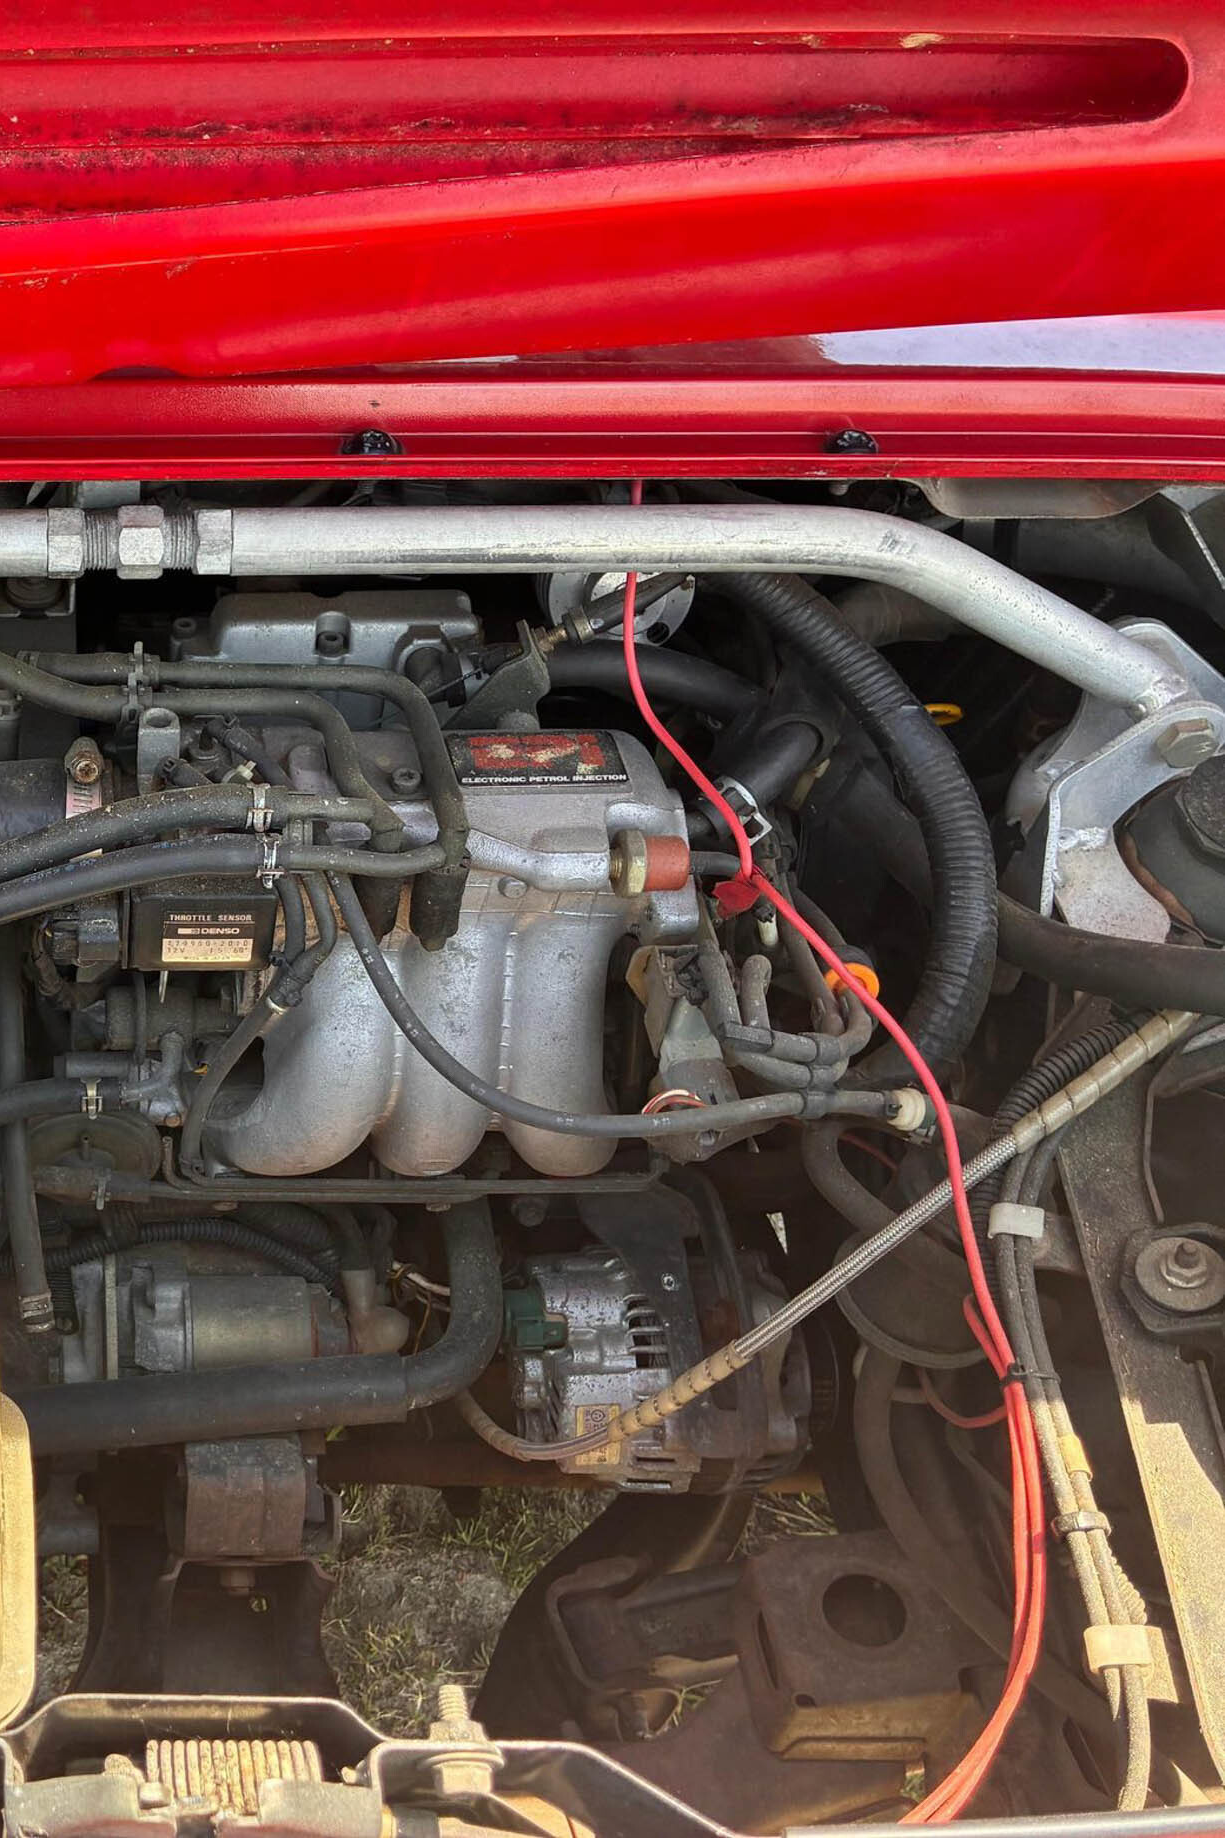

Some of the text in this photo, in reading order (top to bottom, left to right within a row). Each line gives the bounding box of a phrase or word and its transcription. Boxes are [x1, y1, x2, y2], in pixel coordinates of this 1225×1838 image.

[461, 774, 627, 784] ELECTRONIC PETROL INJECTION
[200, 927, 240, 935] DENSO
